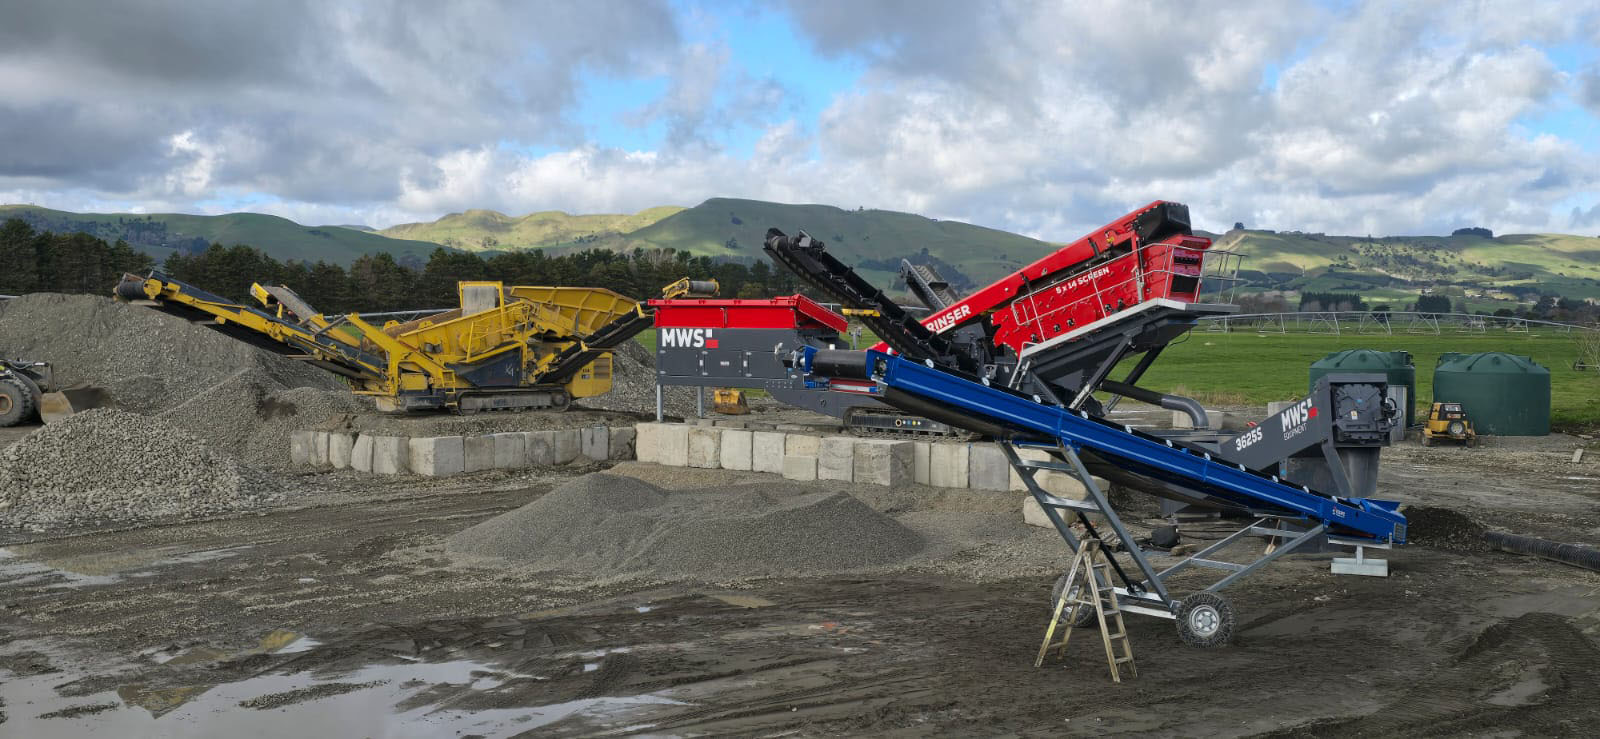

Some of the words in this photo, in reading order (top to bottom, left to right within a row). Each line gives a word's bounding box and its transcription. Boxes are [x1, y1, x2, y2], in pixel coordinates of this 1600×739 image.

[1077, 266, 1110, 285] SCREEN
[925, 304, 971, 332] RINSER
[661, 328, 704, 348] MWS
[1281, 401, 1308, 432] MWS
